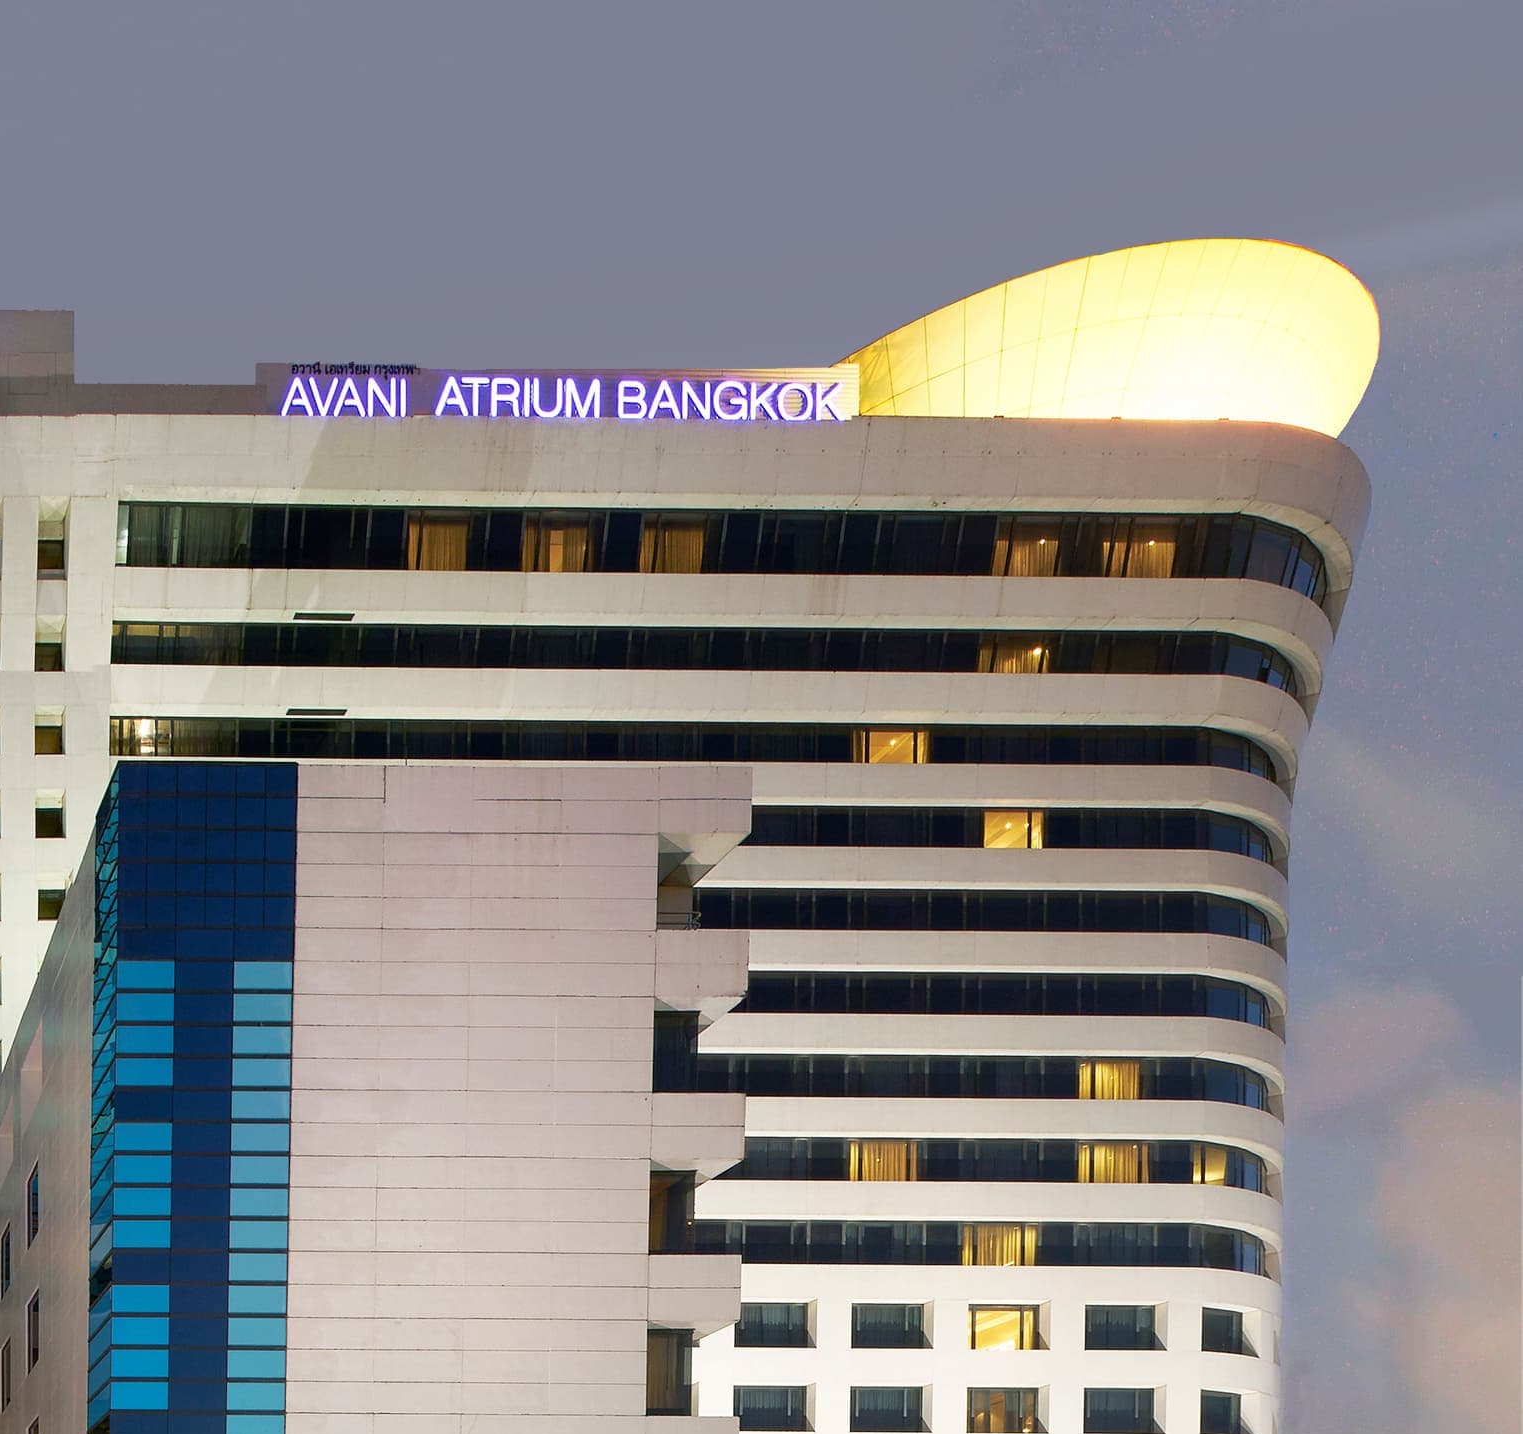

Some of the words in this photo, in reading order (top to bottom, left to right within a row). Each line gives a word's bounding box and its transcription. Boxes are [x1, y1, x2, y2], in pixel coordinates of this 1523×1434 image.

[281, 377, 406, 417] AVANI
[434, 376, 600, 418] ATRIUM
[617, 380, 848, 421] BANGKOK
